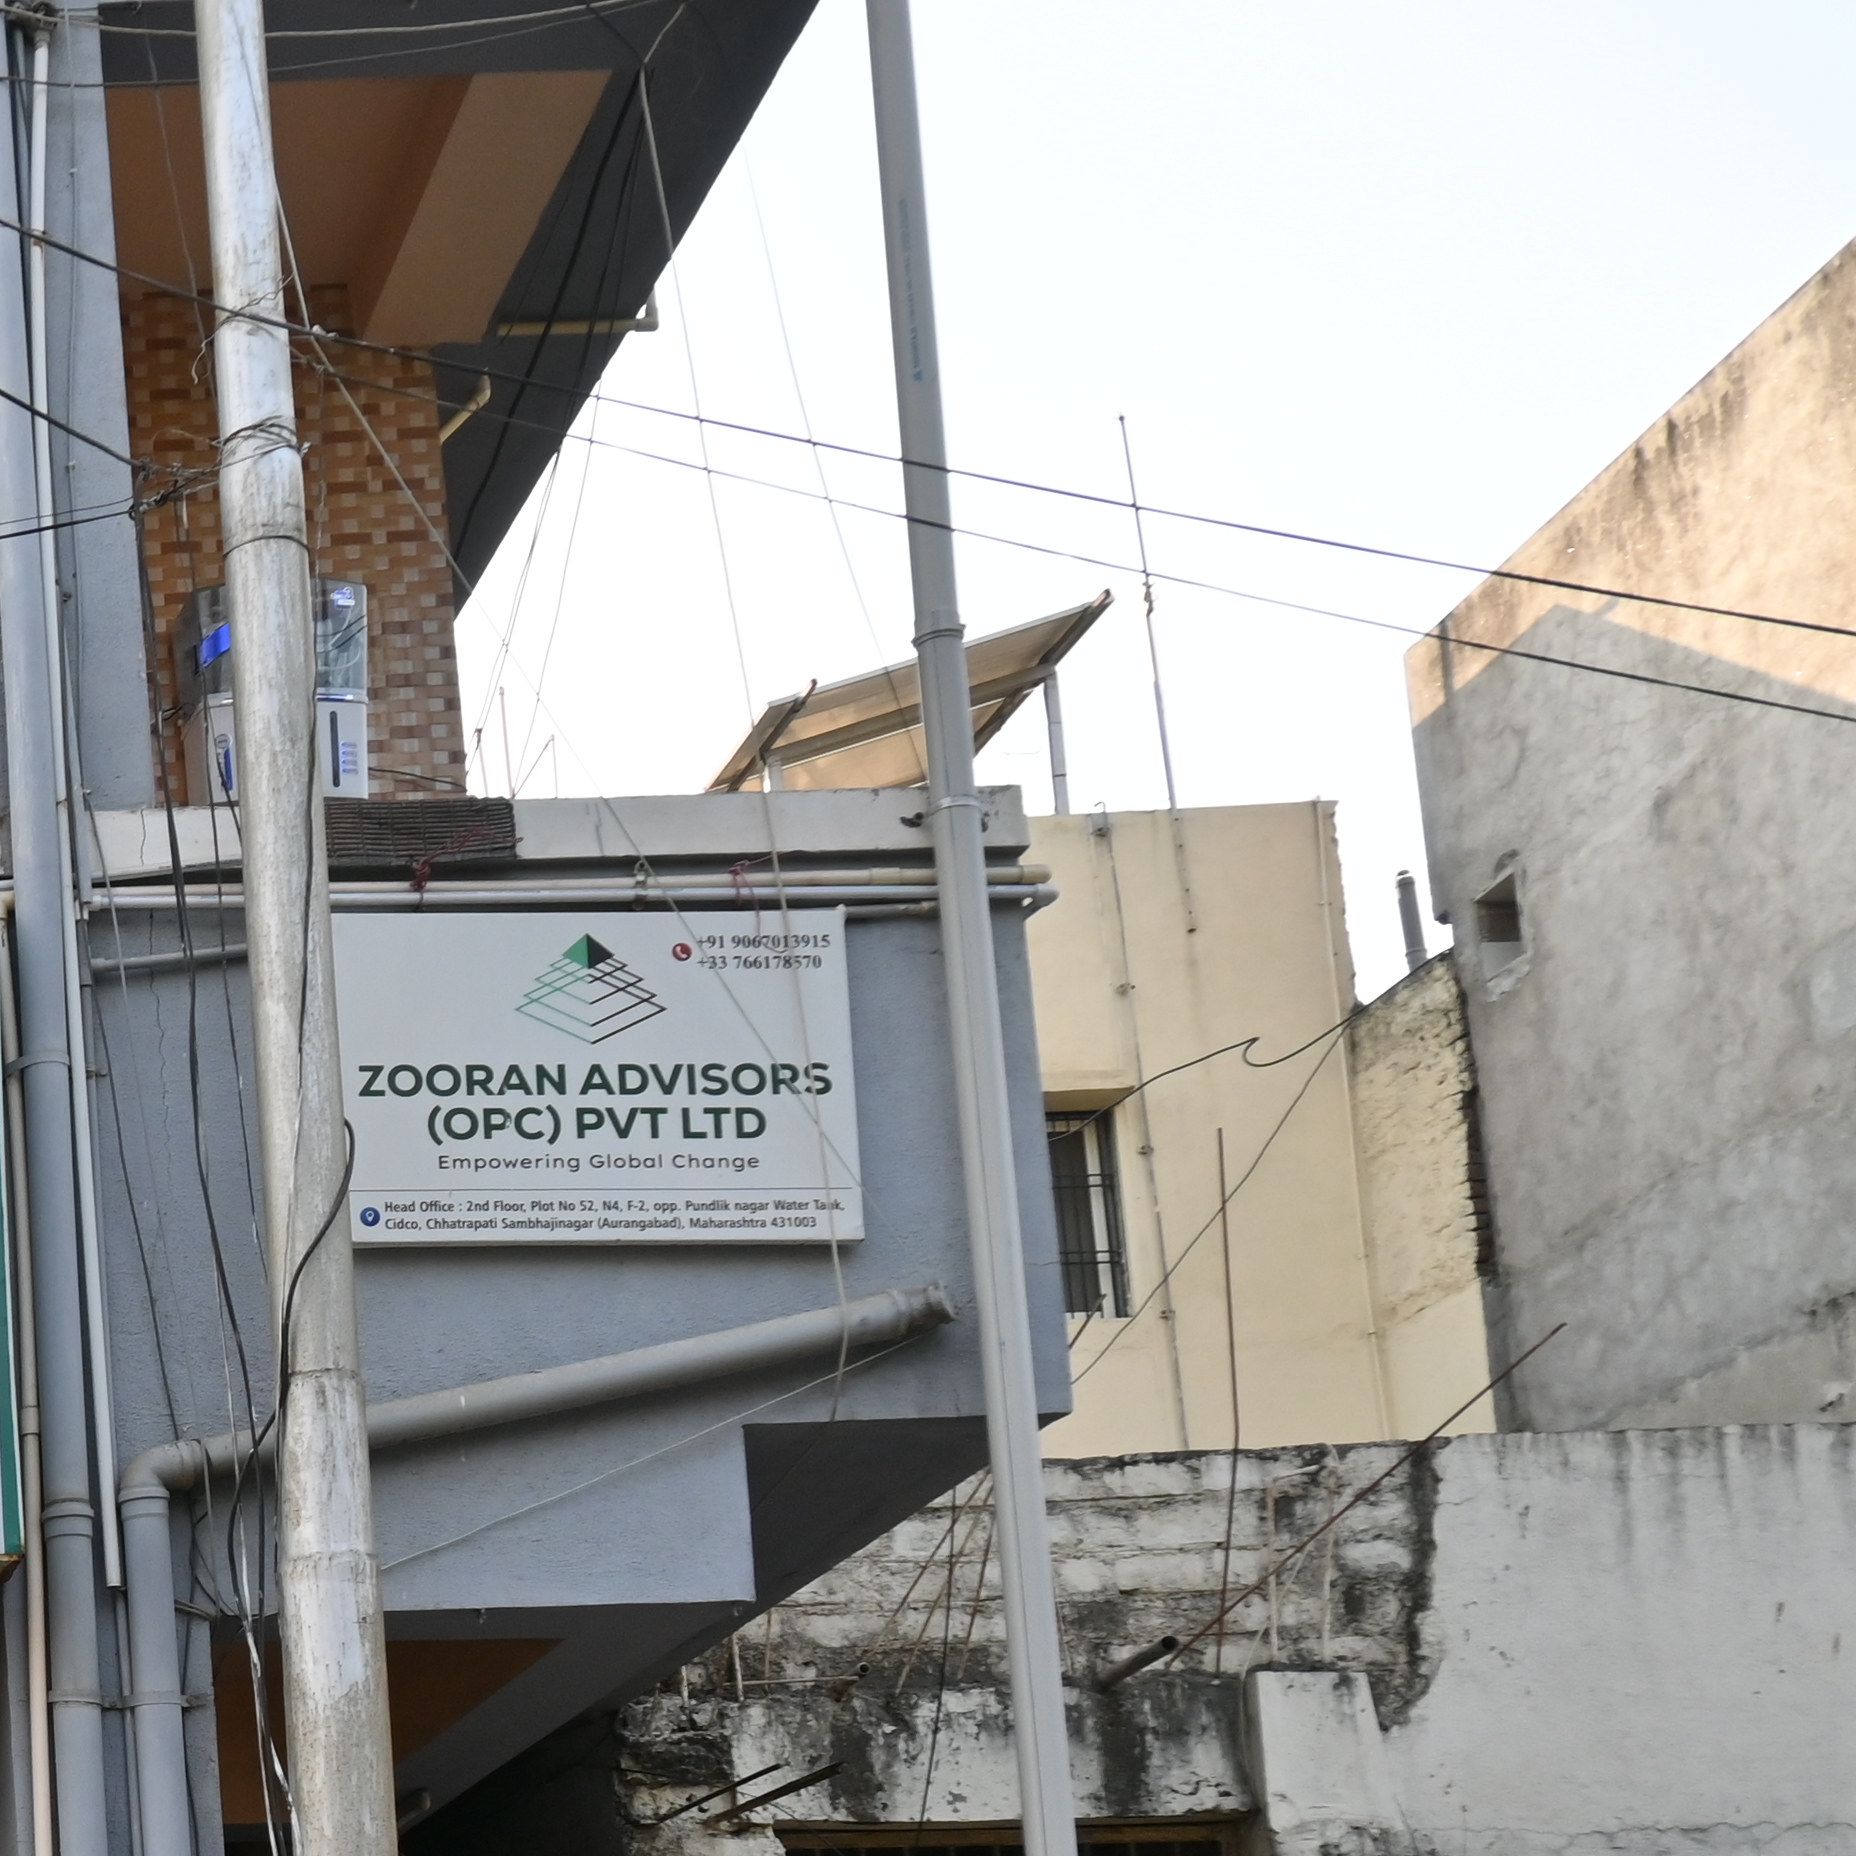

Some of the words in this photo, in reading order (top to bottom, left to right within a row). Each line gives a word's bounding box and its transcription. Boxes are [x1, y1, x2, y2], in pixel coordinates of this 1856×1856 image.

[733, 955, 822, 969] 766178570
[358, 1063, 567, 1098] ZOORAN
[578, 1062, 833, 1096] ADVISORS
[428, 1104, 562, 1145] (OPC)
[576, 1106, 668, 1140] PVT
[681, 1106, 767, 1139] LTD
[437, 1153, 581, 1173] Empowering
[589, 1153, 663, 1170] Global
[672, 1153, 761, 1171] Change
[419, 1201, 455, 1212] Office
[426, 1217, 497, 1231] Chhatrapati
[501, 1217, 594, 1231] Sambhajinagar
[689, 1216, 767, 1229] Maharashtra
[770, 1217, 817, 1228] 431003
